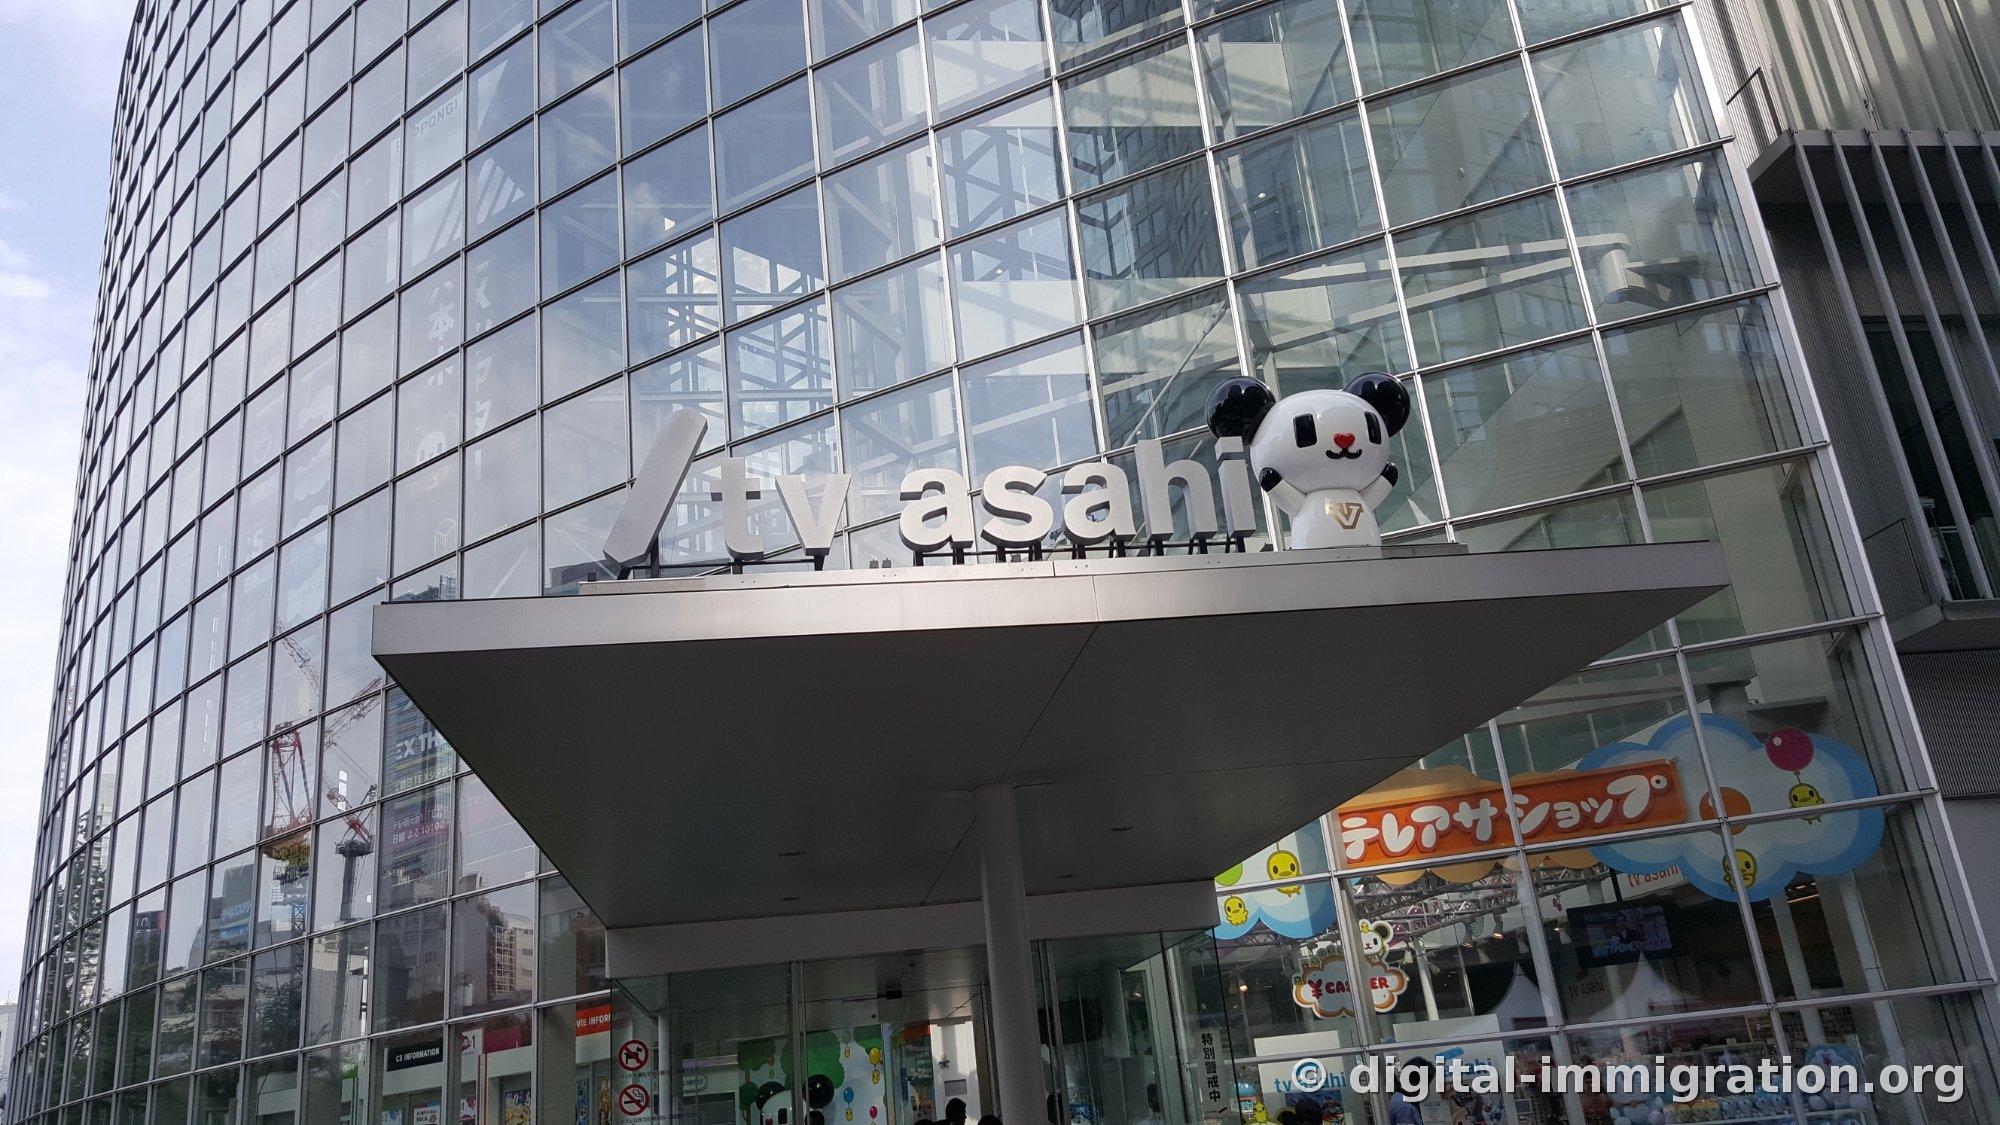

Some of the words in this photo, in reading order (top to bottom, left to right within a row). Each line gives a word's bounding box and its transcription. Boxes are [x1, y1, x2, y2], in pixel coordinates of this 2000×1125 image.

[710, 457, 851, 557] tv
[899, 438, 1257, 552] asahi
[1342, 774, 1668, 860] テレアサショップ
[404, 1047, 440, 1061] INFORMATION
[1201, 1032, 1221, 1103] 特別警戒中
[1273, 1077, 1293, 1094] tv
